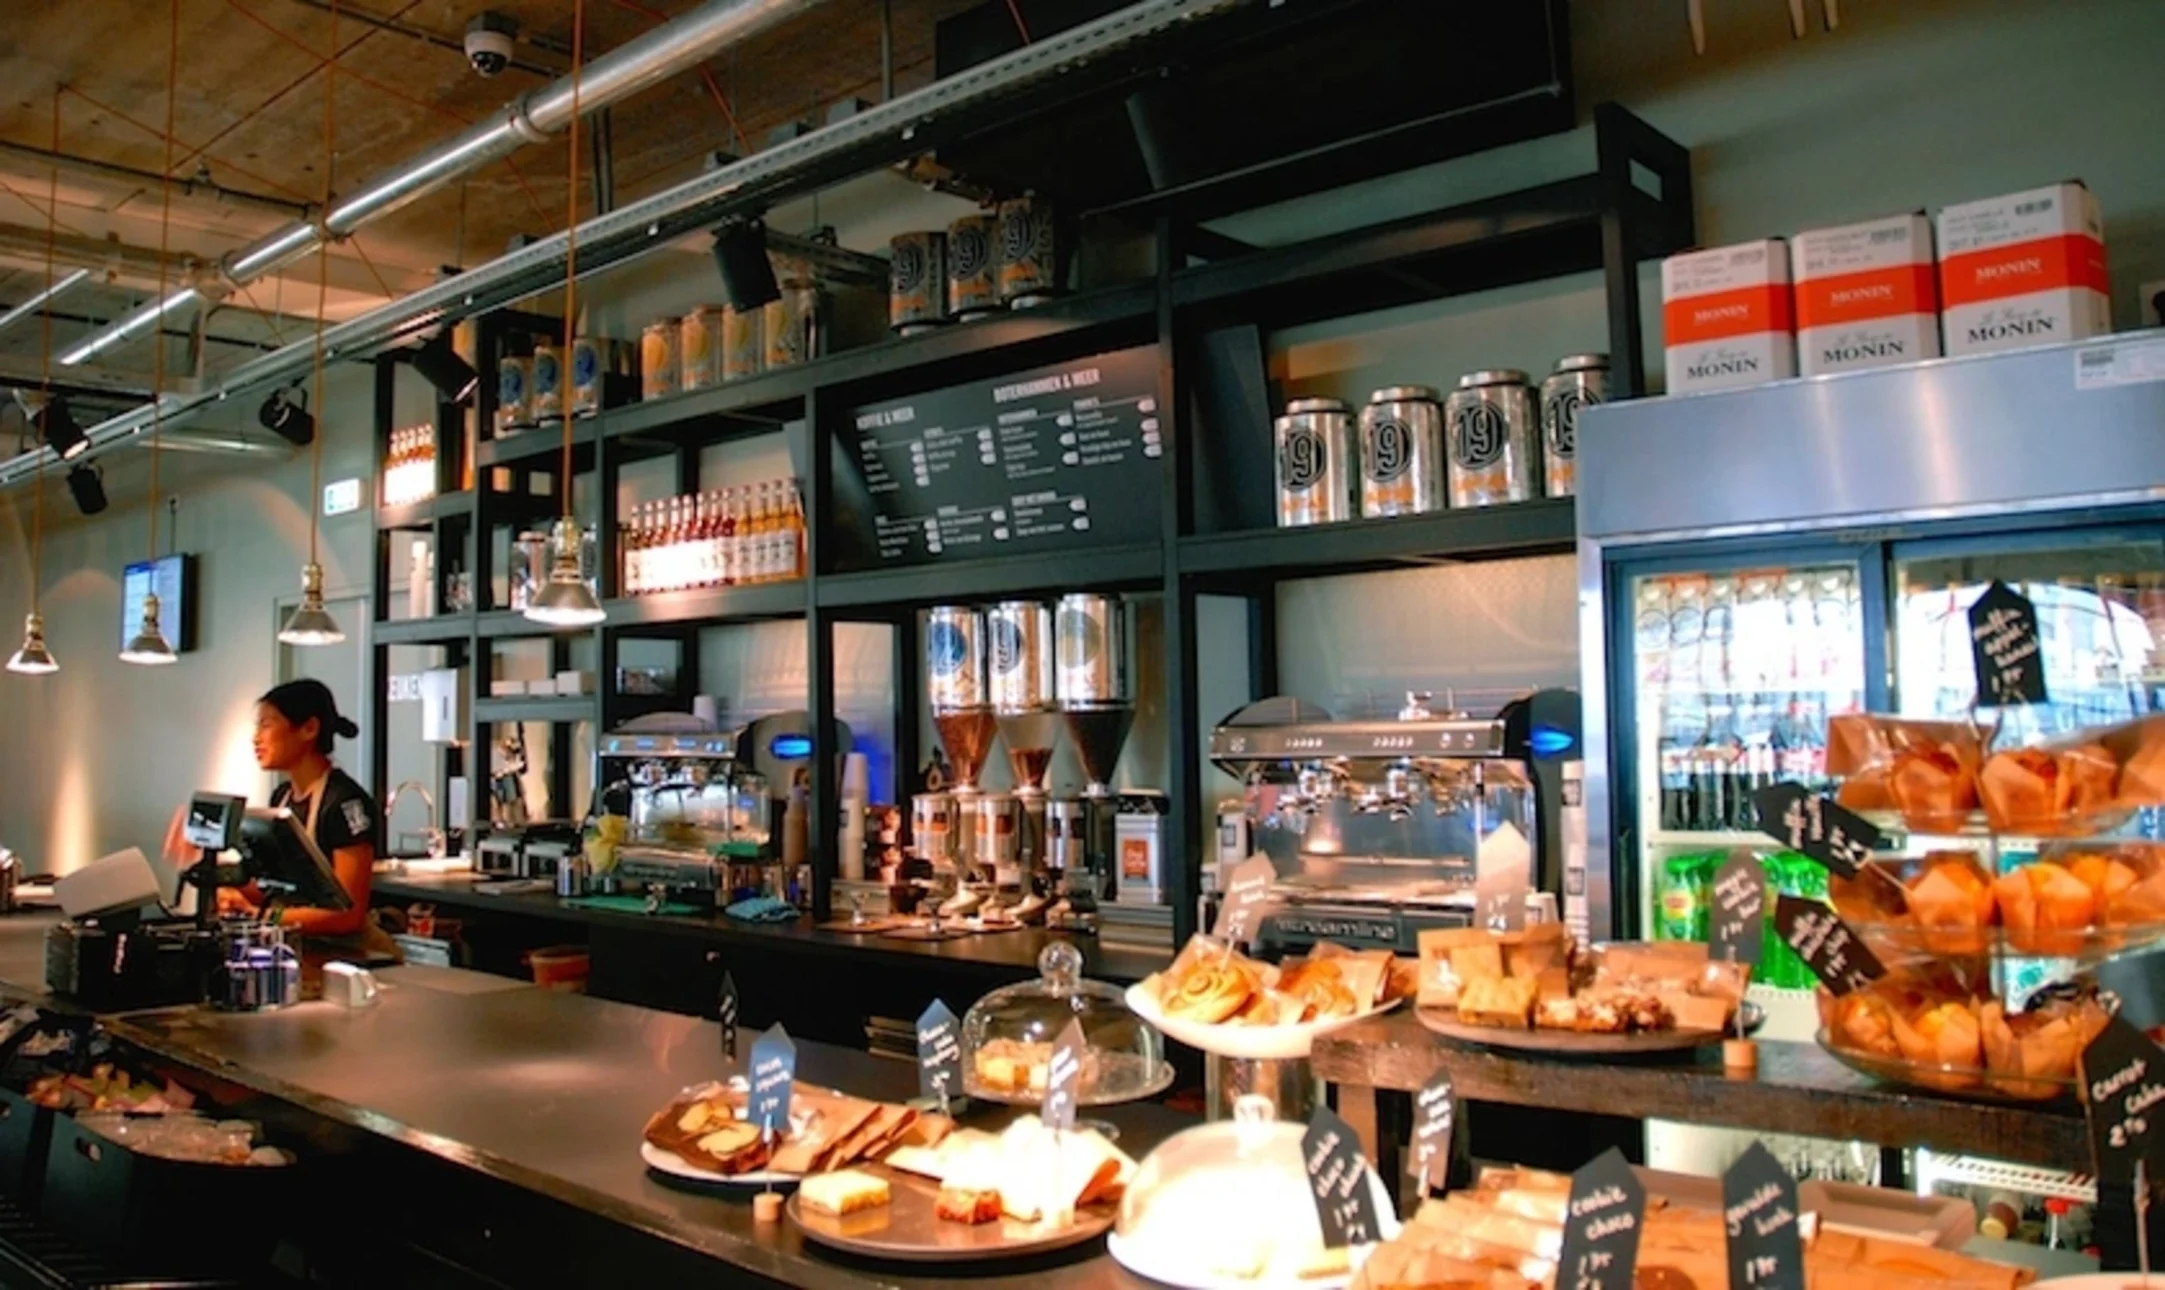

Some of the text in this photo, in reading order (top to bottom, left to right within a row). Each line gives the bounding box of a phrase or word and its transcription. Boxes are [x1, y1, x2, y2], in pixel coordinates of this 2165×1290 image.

[1975, 256, 2041, 281] MONIN
[1830, 283, 1893, 305] MONIN
[1693, 304, 1749, 325] MONIN
[1968, 318, 2055, 344] MONIN
[1823, 341, 1904, 364] MONIN
[1687, 357, 1758, 380] MONIN
